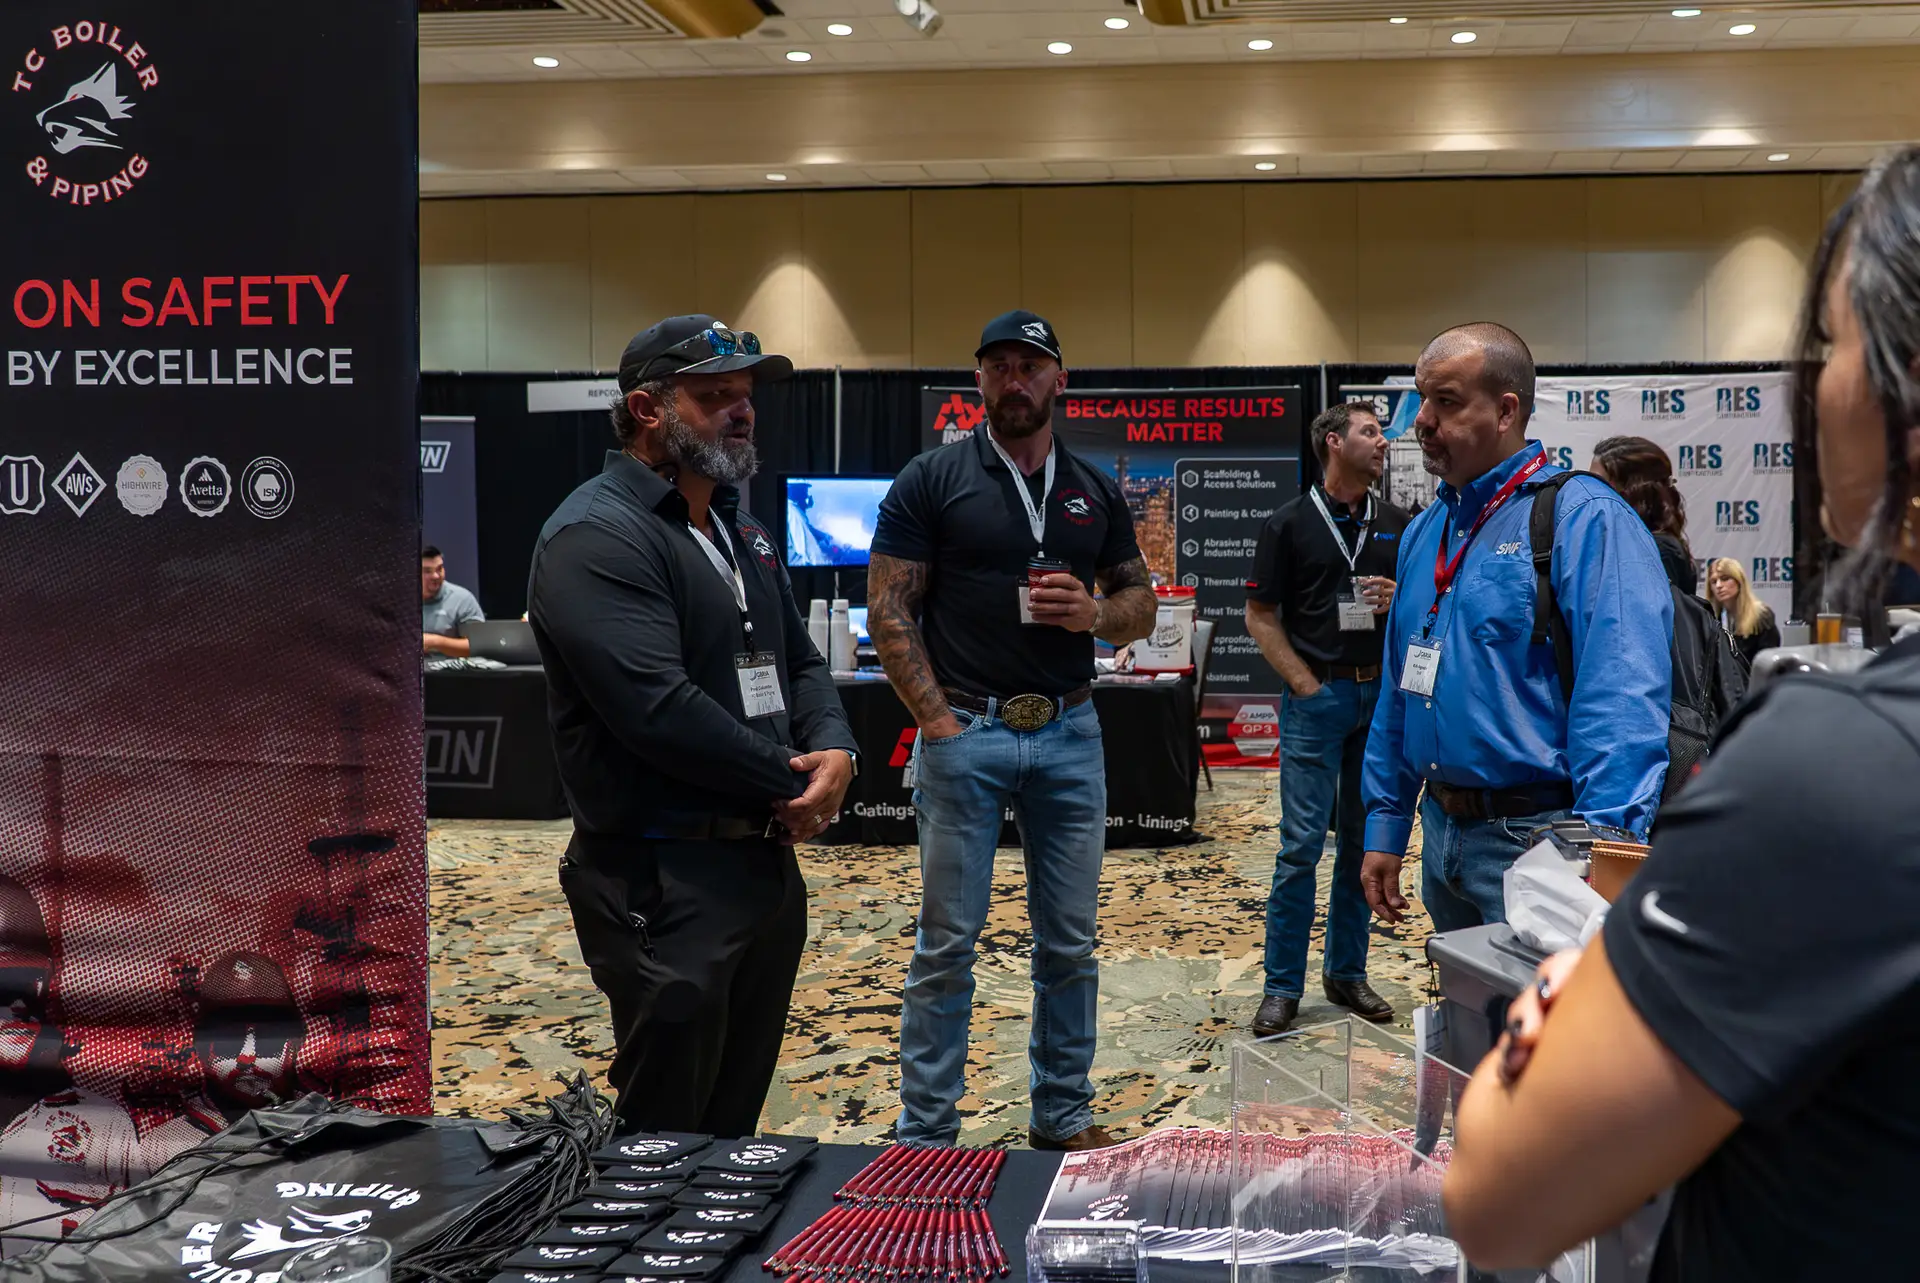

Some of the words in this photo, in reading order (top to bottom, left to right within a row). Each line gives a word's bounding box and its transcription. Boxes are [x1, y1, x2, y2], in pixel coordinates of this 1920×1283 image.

[12, 48, 45, 92] TC
[51, 20, 159, 91] BOILER
[26, 156, 48, 186] &
[50, 153, 149, 205] PIPING
[13, 278, 100, 328] ON
[121, 274, 350, 327] SAFETY
[8, 350, 61, 386] BY
[75, 348, 354, 385] EXCELLENCE
[1066, 399, 1176, 418] BECAUSE
[1184, 398, 1285, 417] RESULTS
[1567, 390, 1610, 414] RES
[1641, 389, 1685, 414] RES
[1716, 386, 1761, 412] RES
[1127, 422, 1223, 442] MATTER
[1547, 446, 1573, 470] ES
[1679, 444, 1722, 469] RES
[10, 463, 29, 506] U
[66, 473, 93, 496] AWS
[1203, 470, 1251, 480] Scaffolding
[1253, 470, 1260, 479] &
[1203, 480, 1235, 489] Access
[1236, 480, 1276, 489] Solutions
[121, 481, 163, 490] HIGHWIRE
[189, 483, 223, 496] Avetta
[1204, 509, 1239, 519] Painting
[1241, 509, 1248, 518] &
[1250, 509, 1274, 518] Coati
[1716, 500, 1760, 525] RES
[1204, 538, 1241, 547] Abrasive
[1243, 538, 1258, 547] Bla
[1204, 548, 1244, 557] Industrial
[1246, 549, 1255, 557] Cl
[1204, 578, 1238, 586] Thermal
[1204, 607, 1223, 615] Heat
[1214, 635, 1256, 645] eproofing
[1138, 813, 1190, 832] Linings
[276, 1182, 408, 1200] PIPING
